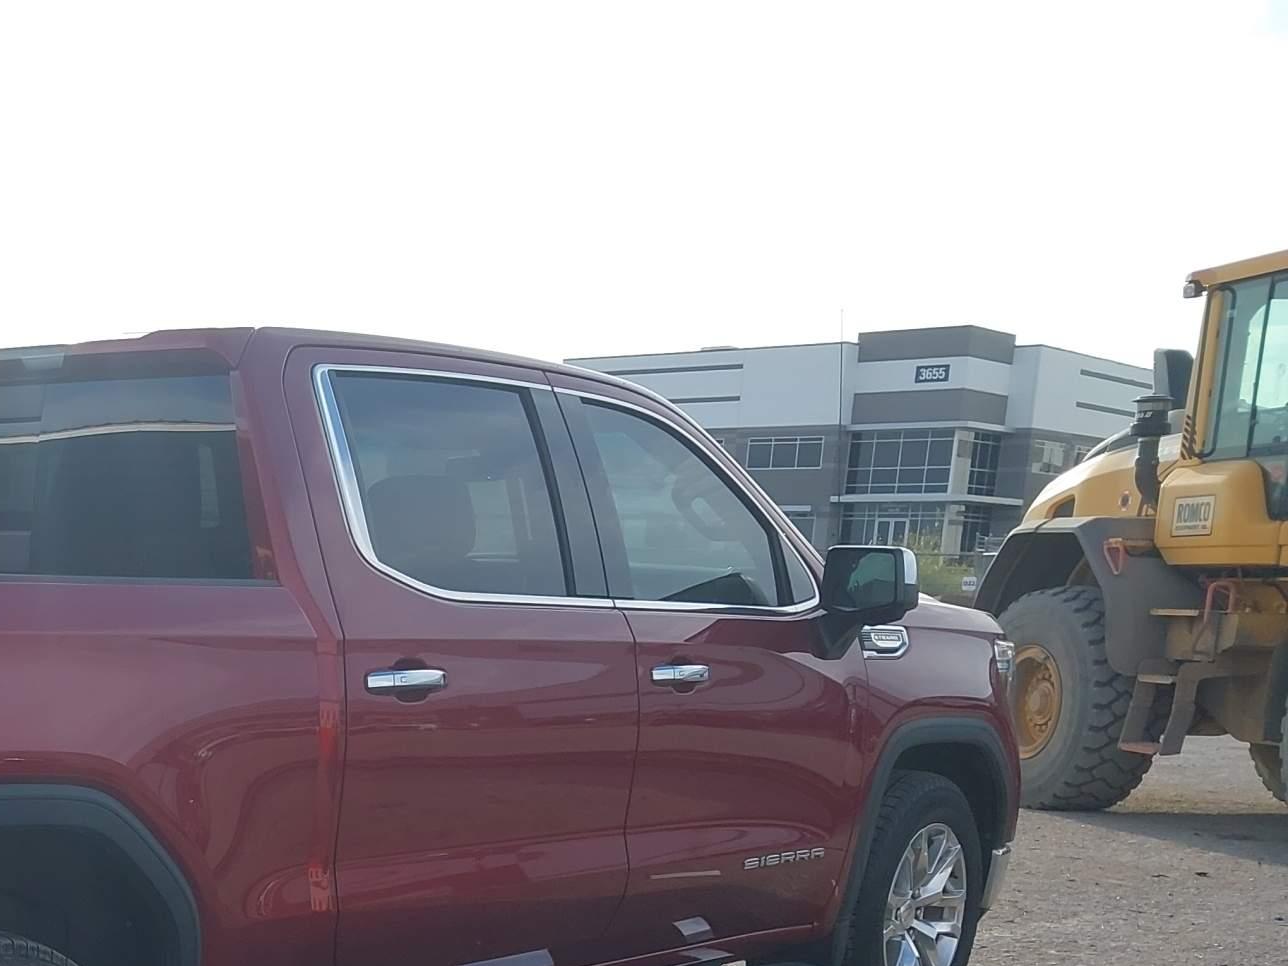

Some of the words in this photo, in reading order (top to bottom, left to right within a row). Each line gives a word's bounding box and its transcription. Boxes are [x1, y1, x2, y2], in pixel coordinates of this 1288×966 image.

[919, 367, 946, 380] 3655
[1176, 502, 1211, 523] ROMCO
[743, 847, 825, 870] SIERRA
